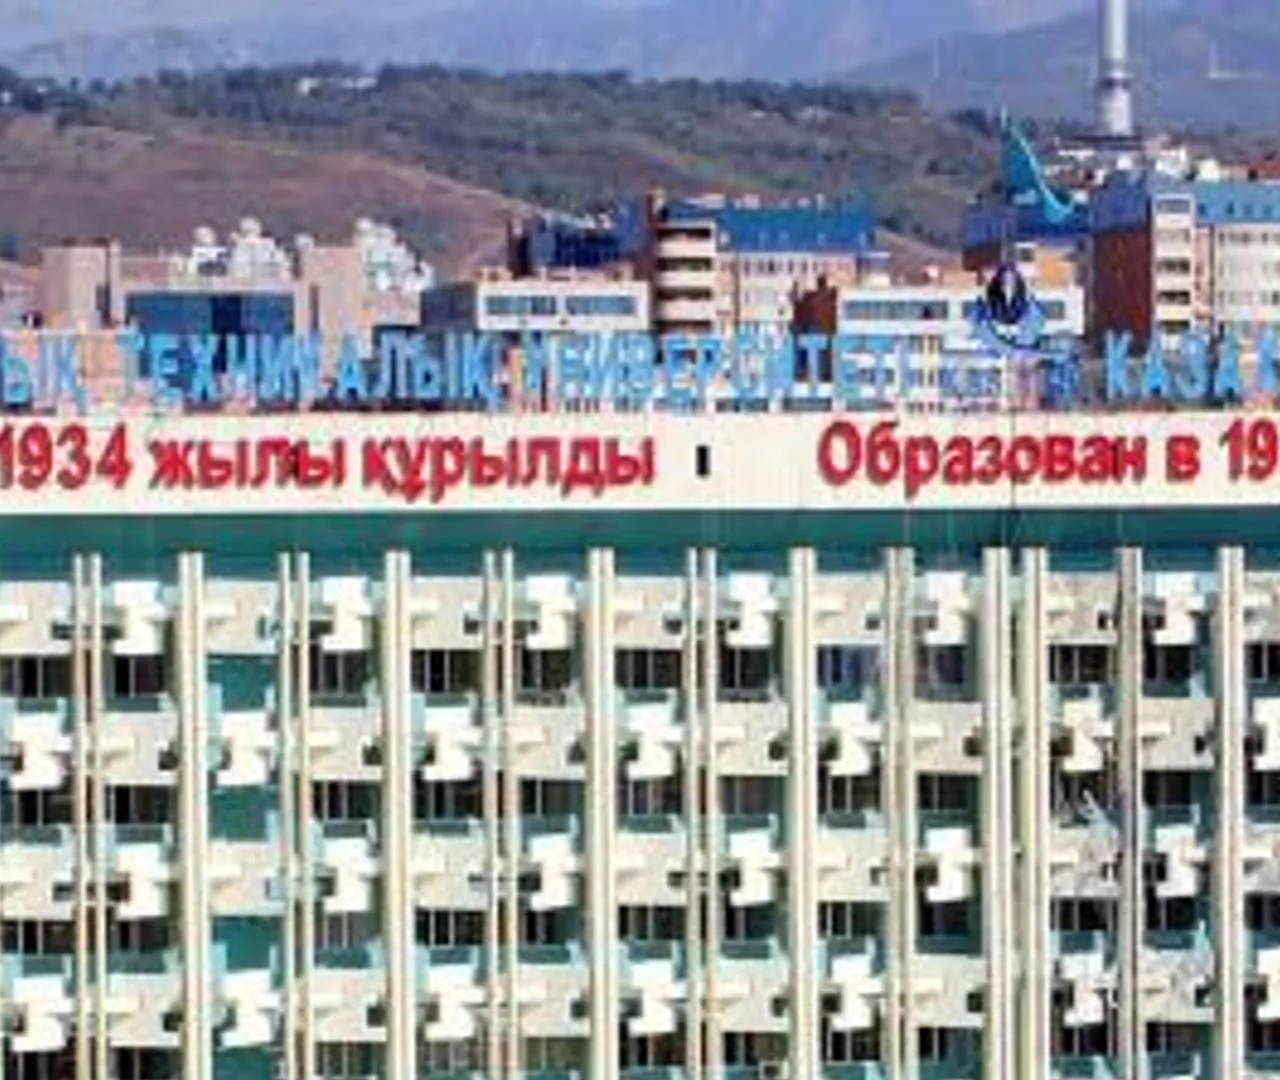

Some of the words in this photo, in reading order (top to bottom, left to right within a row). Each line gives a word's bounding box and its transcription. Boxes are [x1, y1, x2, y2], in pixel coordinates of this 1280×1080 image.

[148, 436, 345, 488] жылы
[818, 420, 1147, 498] Образован
[1165, 436, 1202, 483] в
